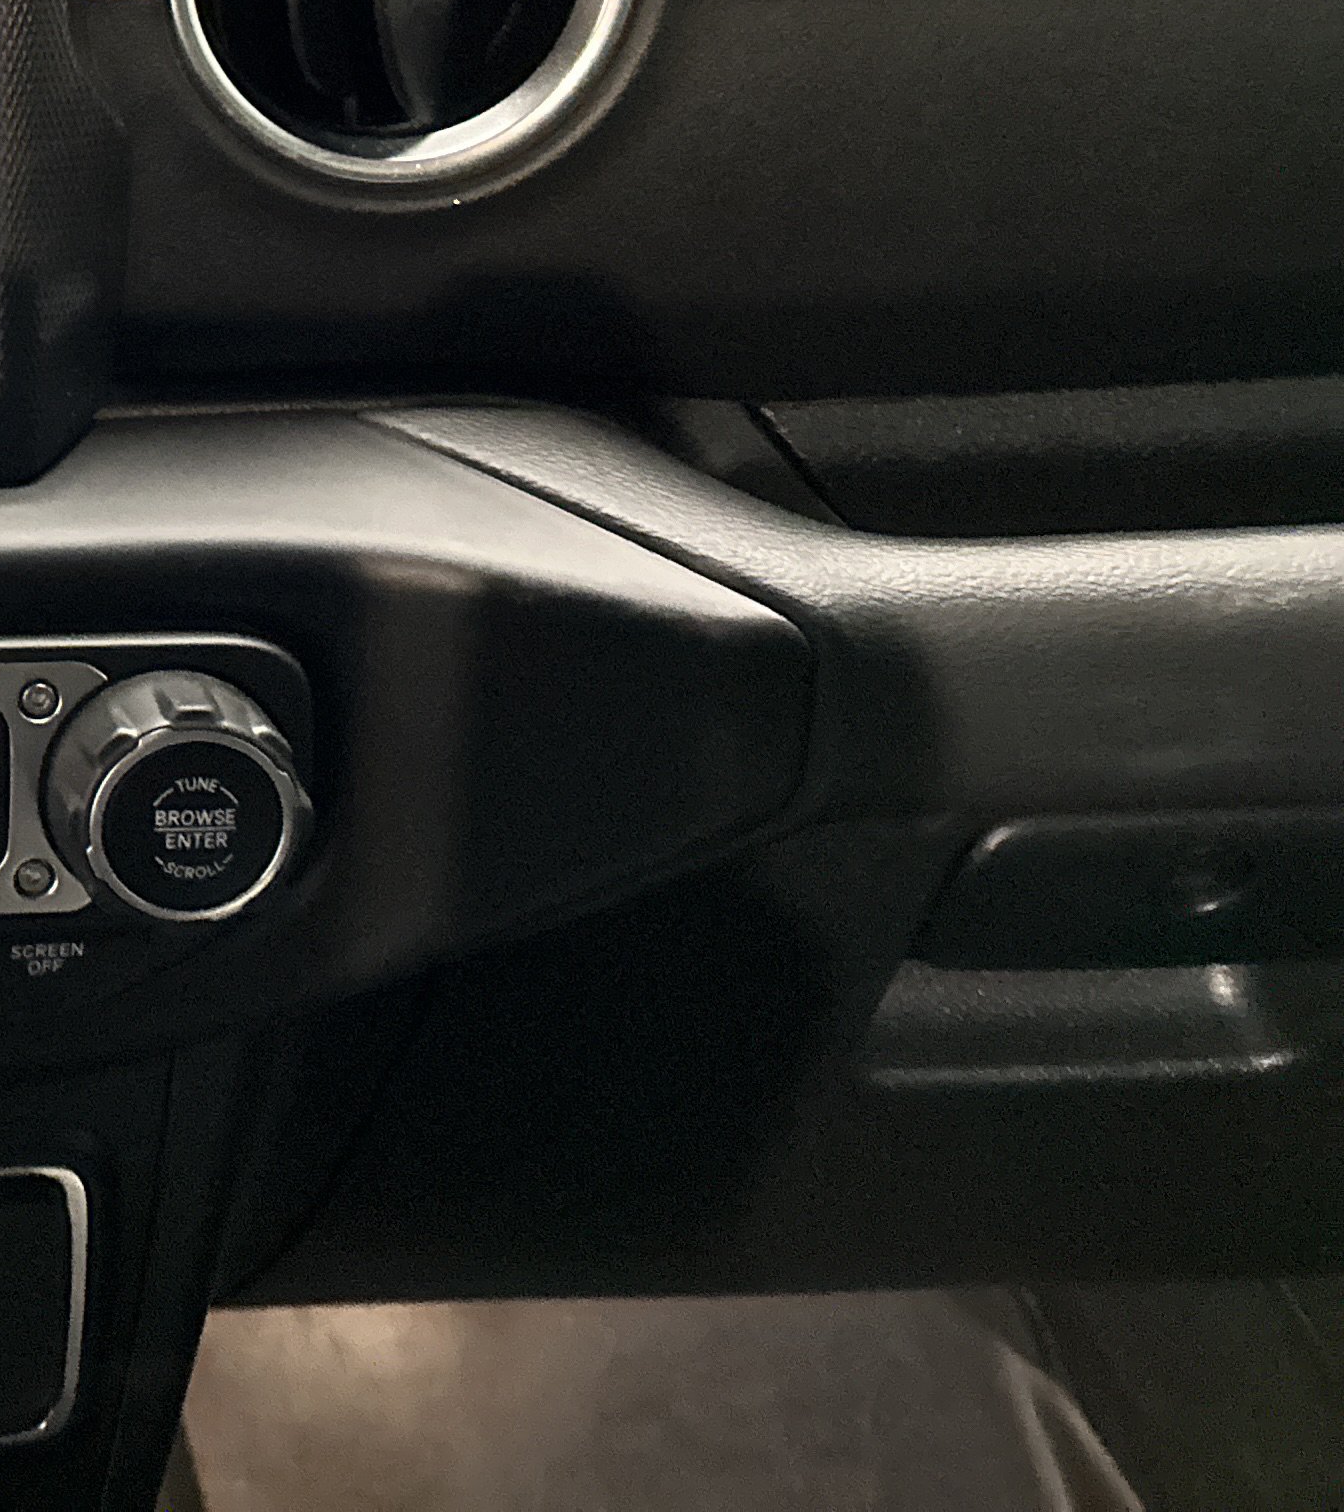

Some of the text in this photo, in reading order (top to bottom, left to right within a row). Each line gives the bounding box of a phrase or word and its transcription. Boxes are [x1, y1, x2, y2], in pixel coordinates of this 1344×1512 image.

[175, 776, 220, 793] TUNE
[155, 808, 236, 826] BROWSE
[165, 832, 227, 849] ENTER
[162, 858, 224, 880] SCROLL
[11, 942, 84, 959] SCREEN
[28, 958, 63, 975] OFF
